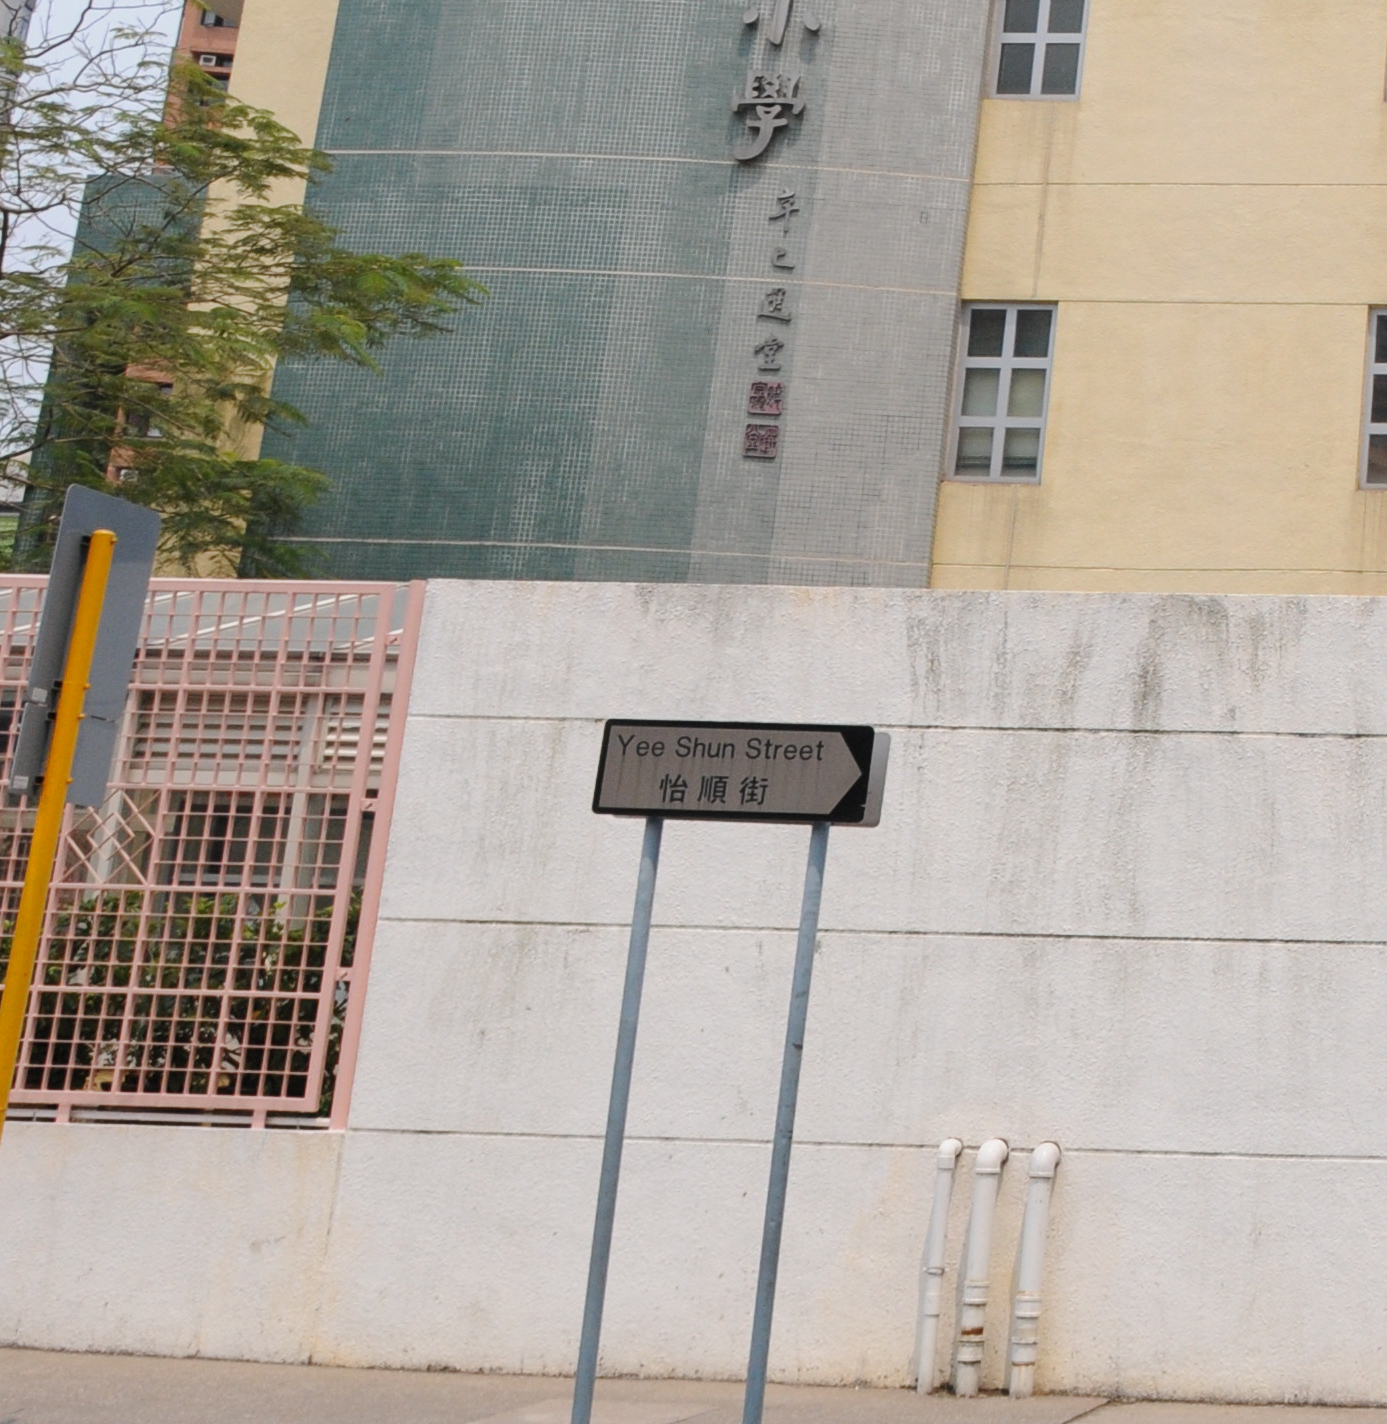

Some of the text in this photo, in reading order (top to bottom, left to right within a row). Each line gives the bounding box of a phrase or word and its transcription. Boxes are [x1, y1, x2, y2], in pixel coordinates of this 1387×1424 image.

[617, 734, 825, 762] Yee Shun Street
[659, 773, 769, 806] 怡順街
